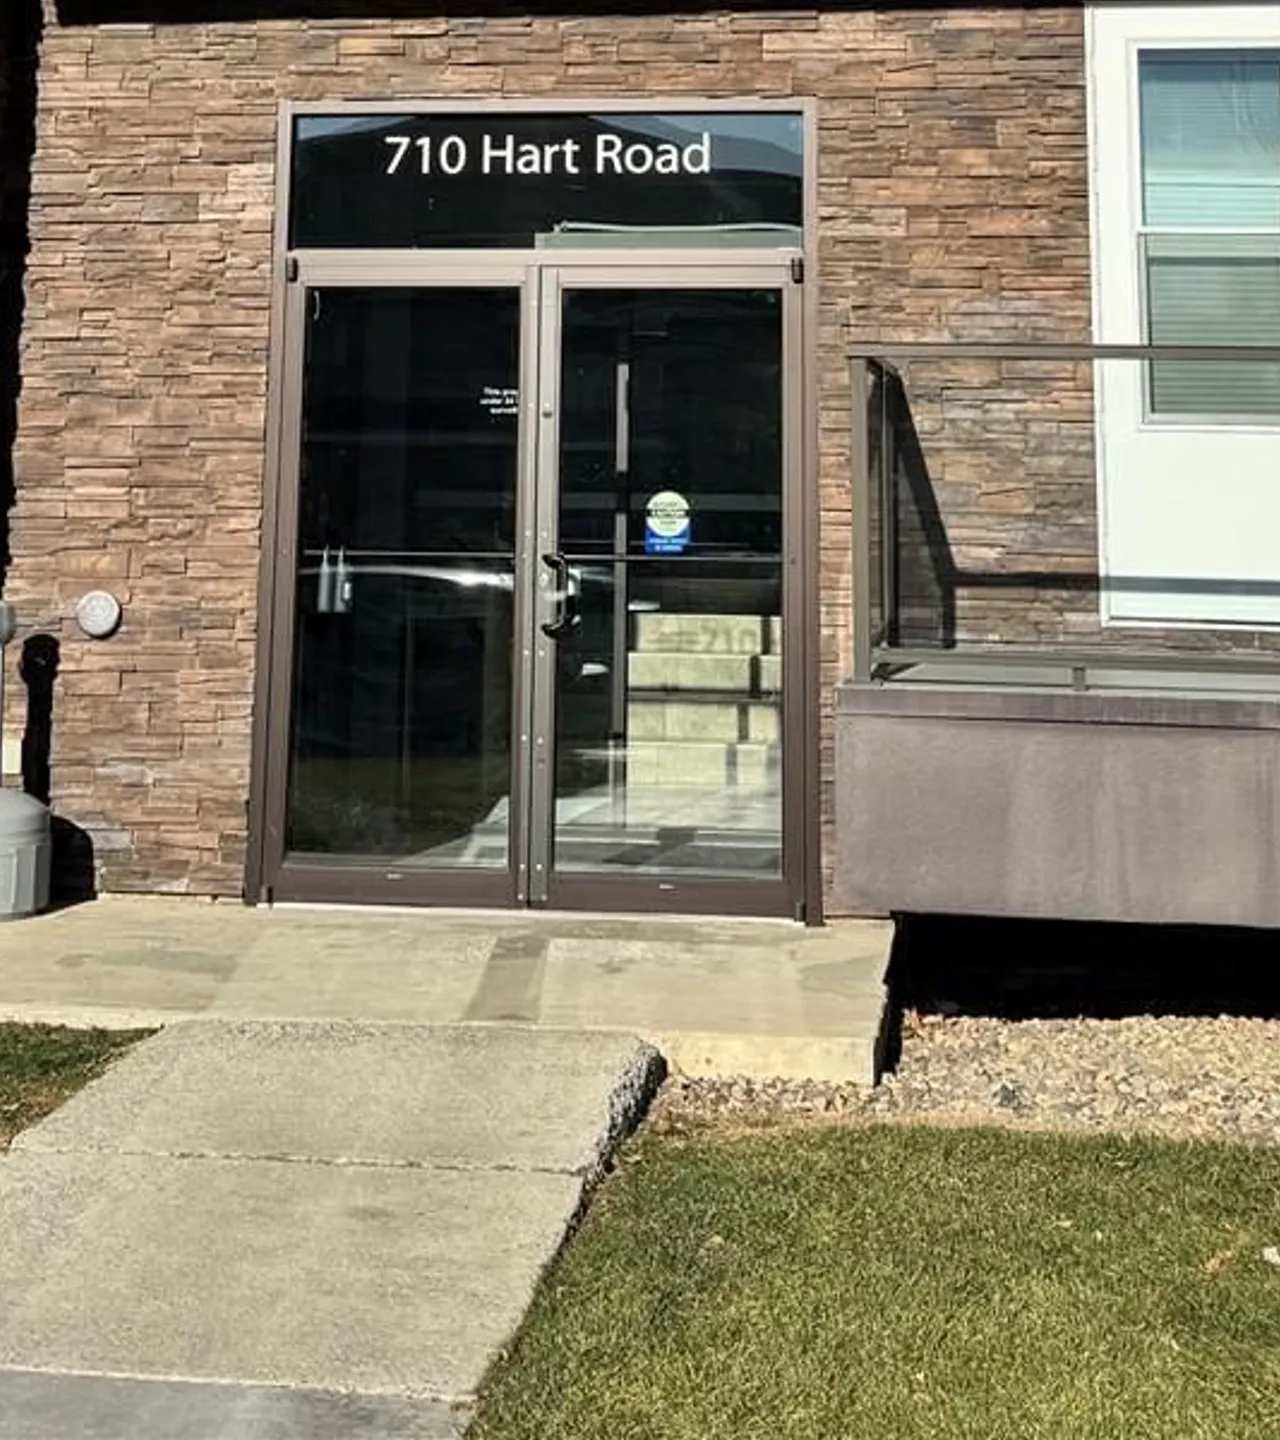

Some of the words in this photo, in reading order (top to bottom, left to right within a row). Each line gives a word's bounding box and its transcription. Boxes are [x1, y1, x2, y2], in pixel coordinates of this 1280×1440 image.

[384, 135, 467, 174] 710
[482, 134, 580, 174] Hart
[596, 132, 712, 174] Road
